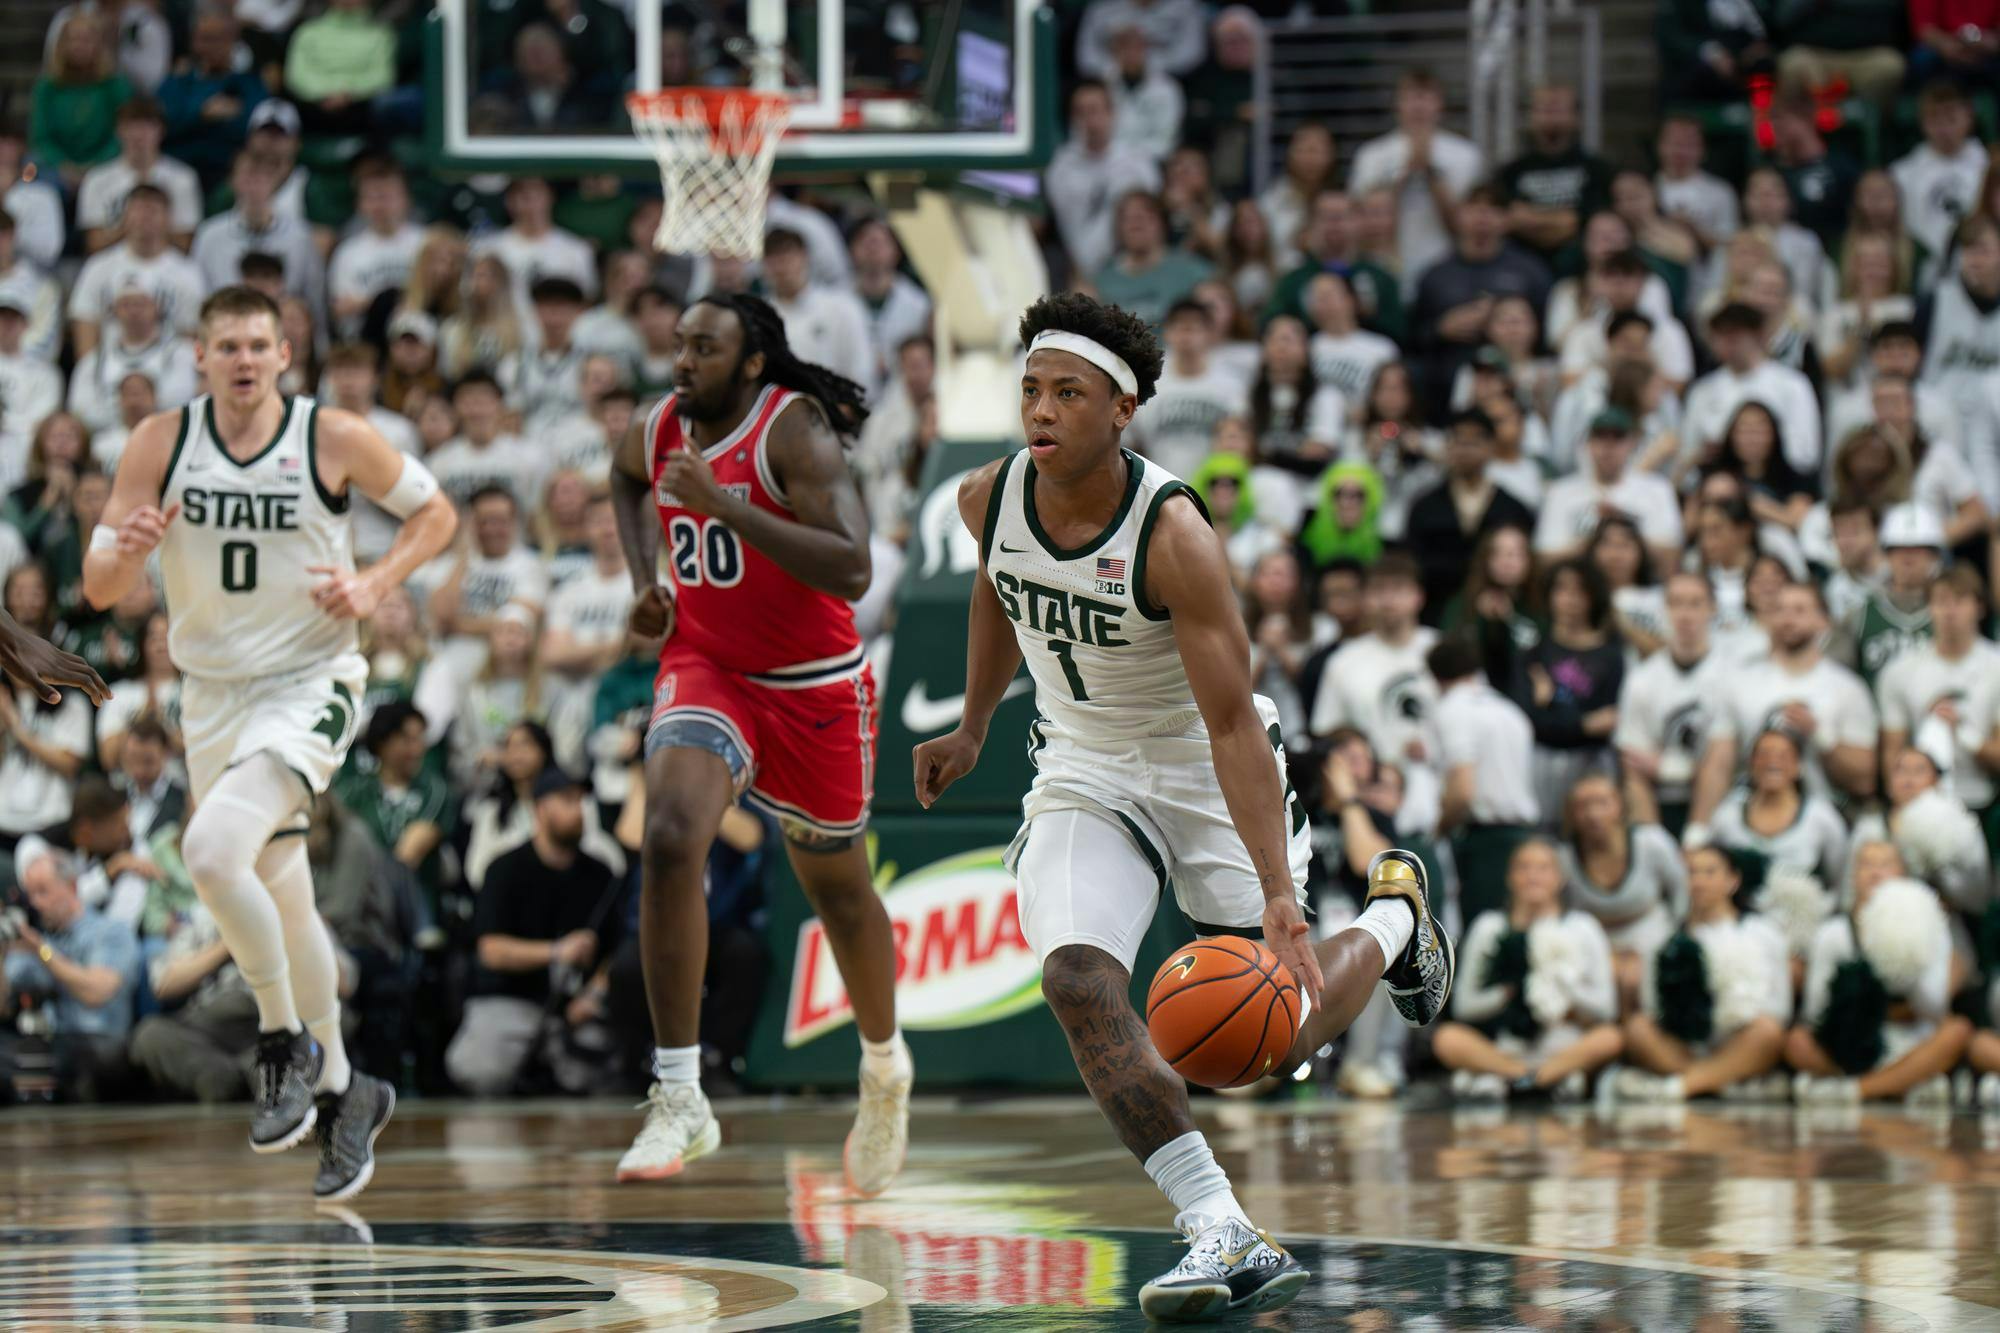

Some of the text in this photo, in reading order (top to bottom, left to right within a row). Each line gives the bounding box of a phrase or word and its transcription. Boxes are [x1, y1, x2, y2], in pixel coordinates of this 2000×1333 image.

[183, 487, 300, 530] STATE
[222, 541, 257, 592] 0
[669, 515, 745, 588] 20
[996, 570, 1132, 647] STATE
[1047, 639, 1091, 701] 1
